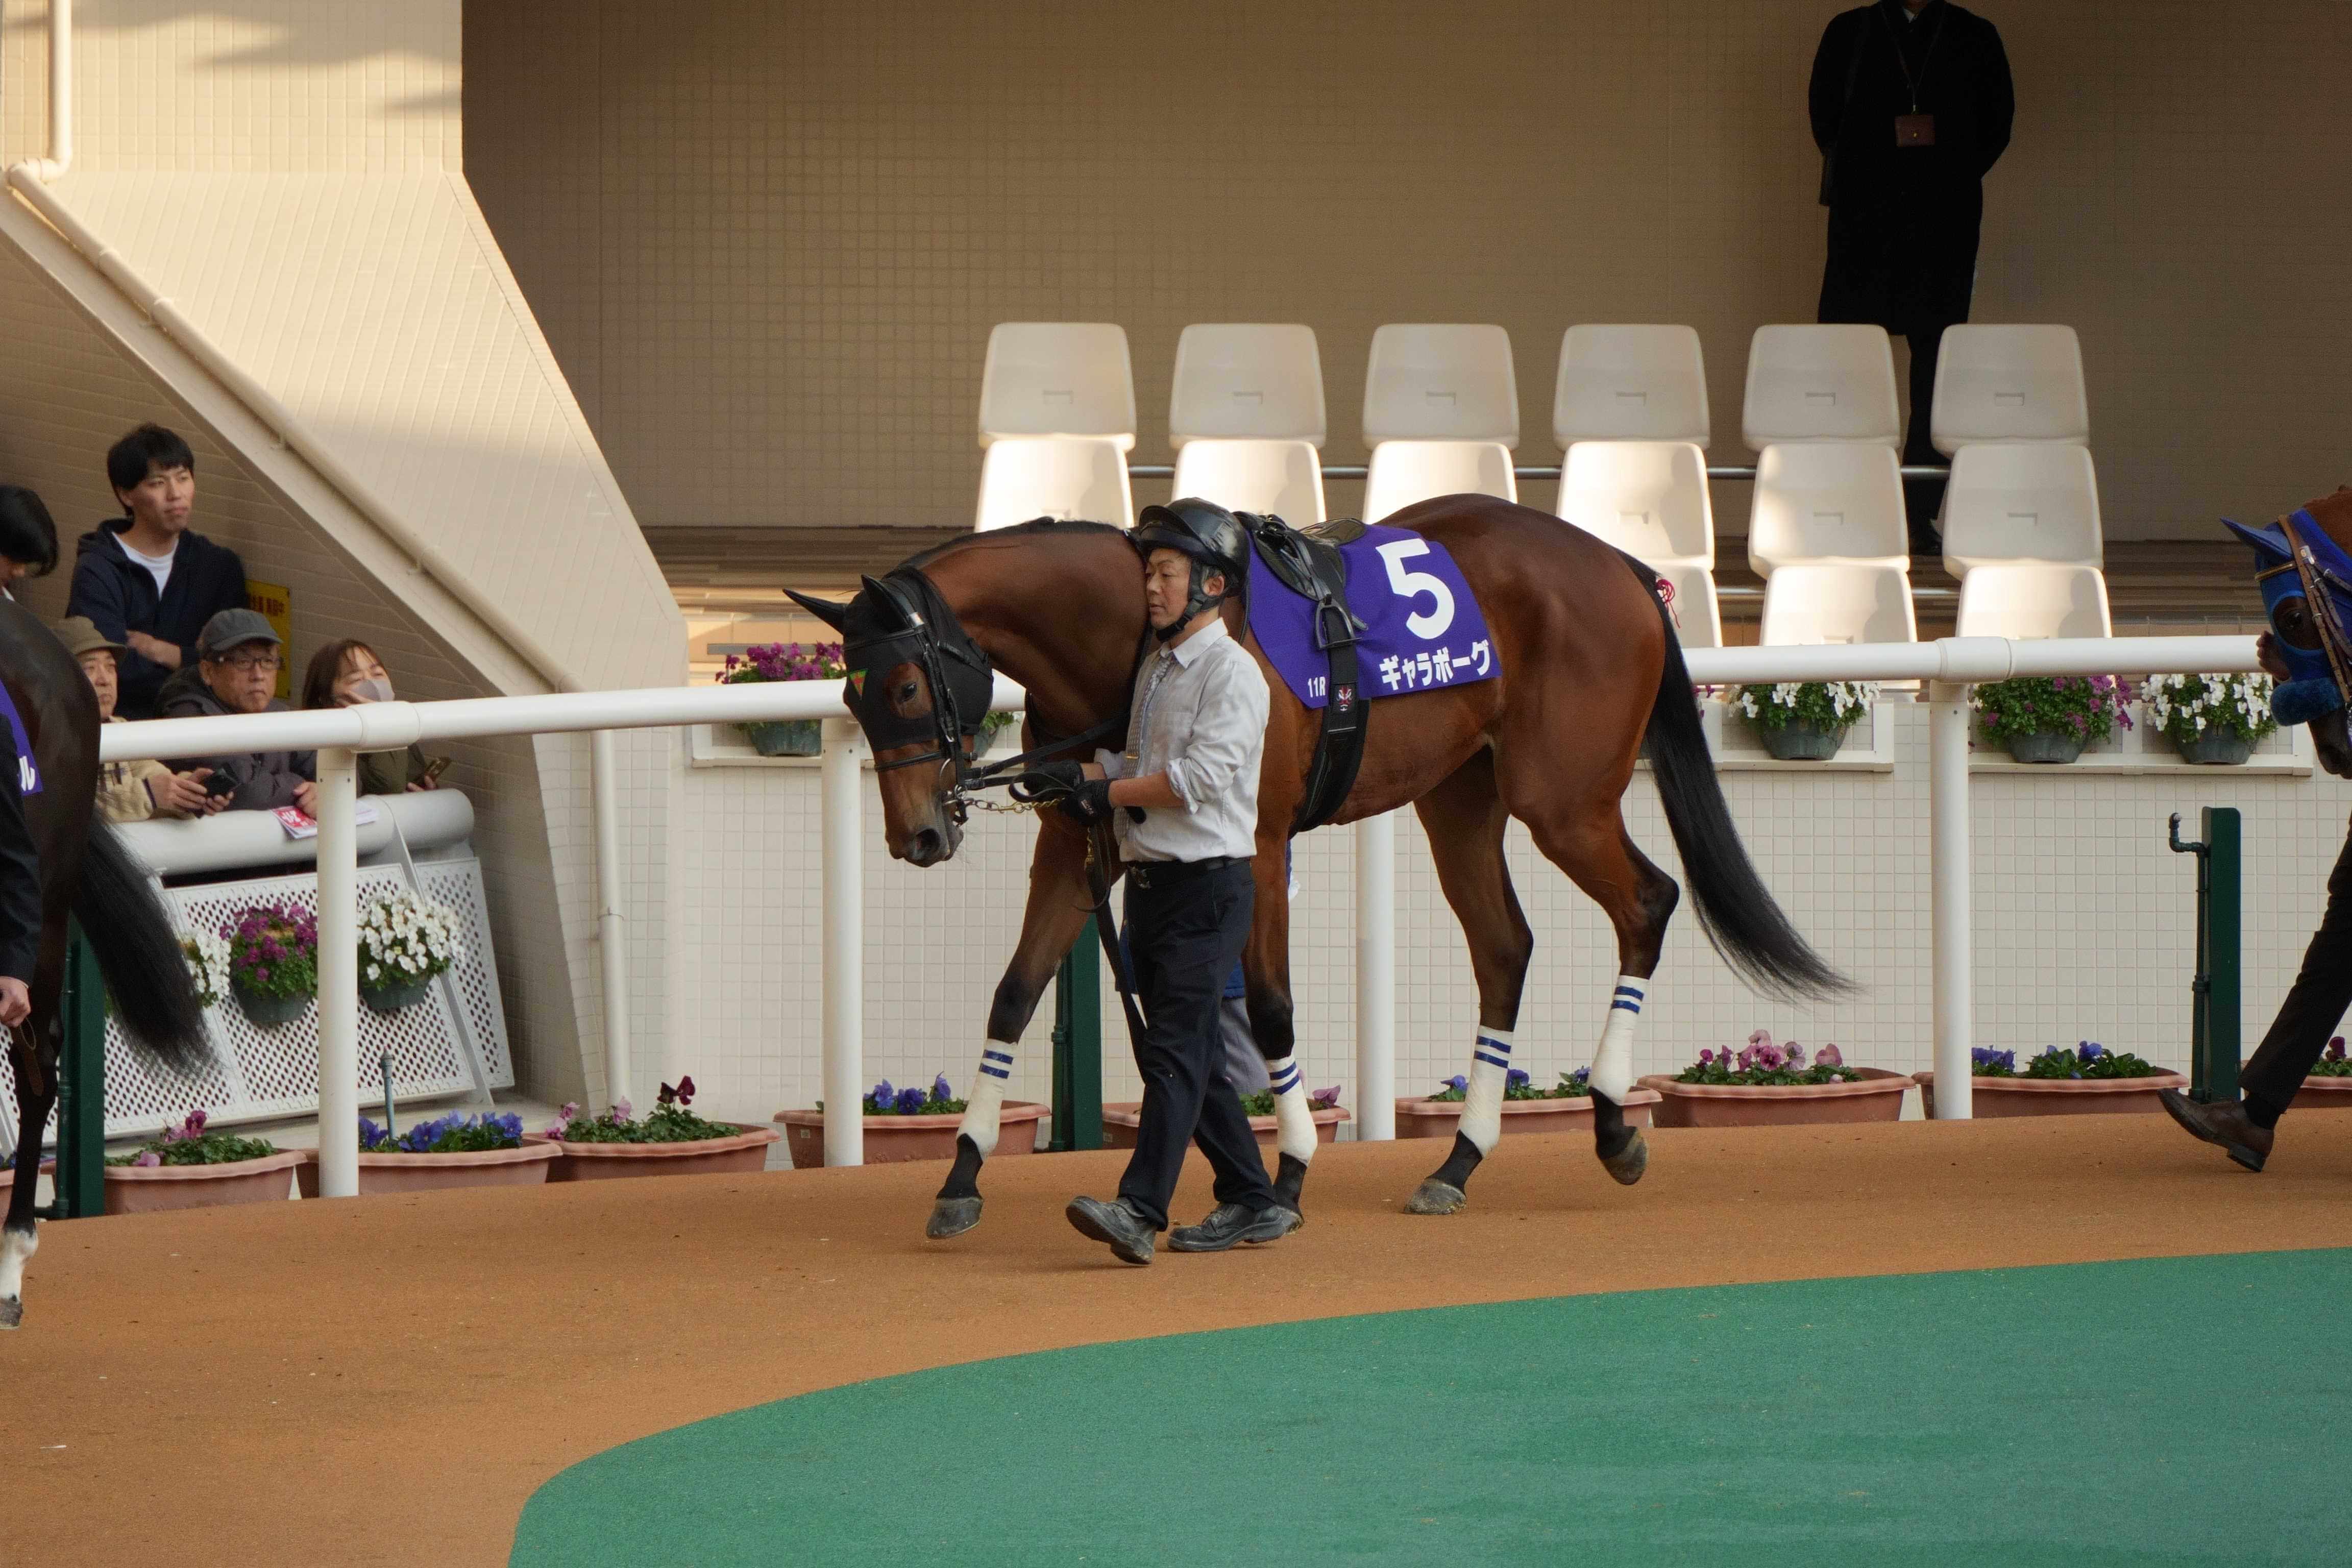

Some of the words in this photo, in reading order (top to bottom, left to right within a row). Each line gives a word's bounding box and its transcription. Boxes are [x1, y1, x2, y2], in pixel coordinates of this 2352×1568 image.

[1376, 538, 1455, 640] 5
[1307, 676, 1326, 698] 11R
[1379, 639, 1490, 691] ギャラボーグ
